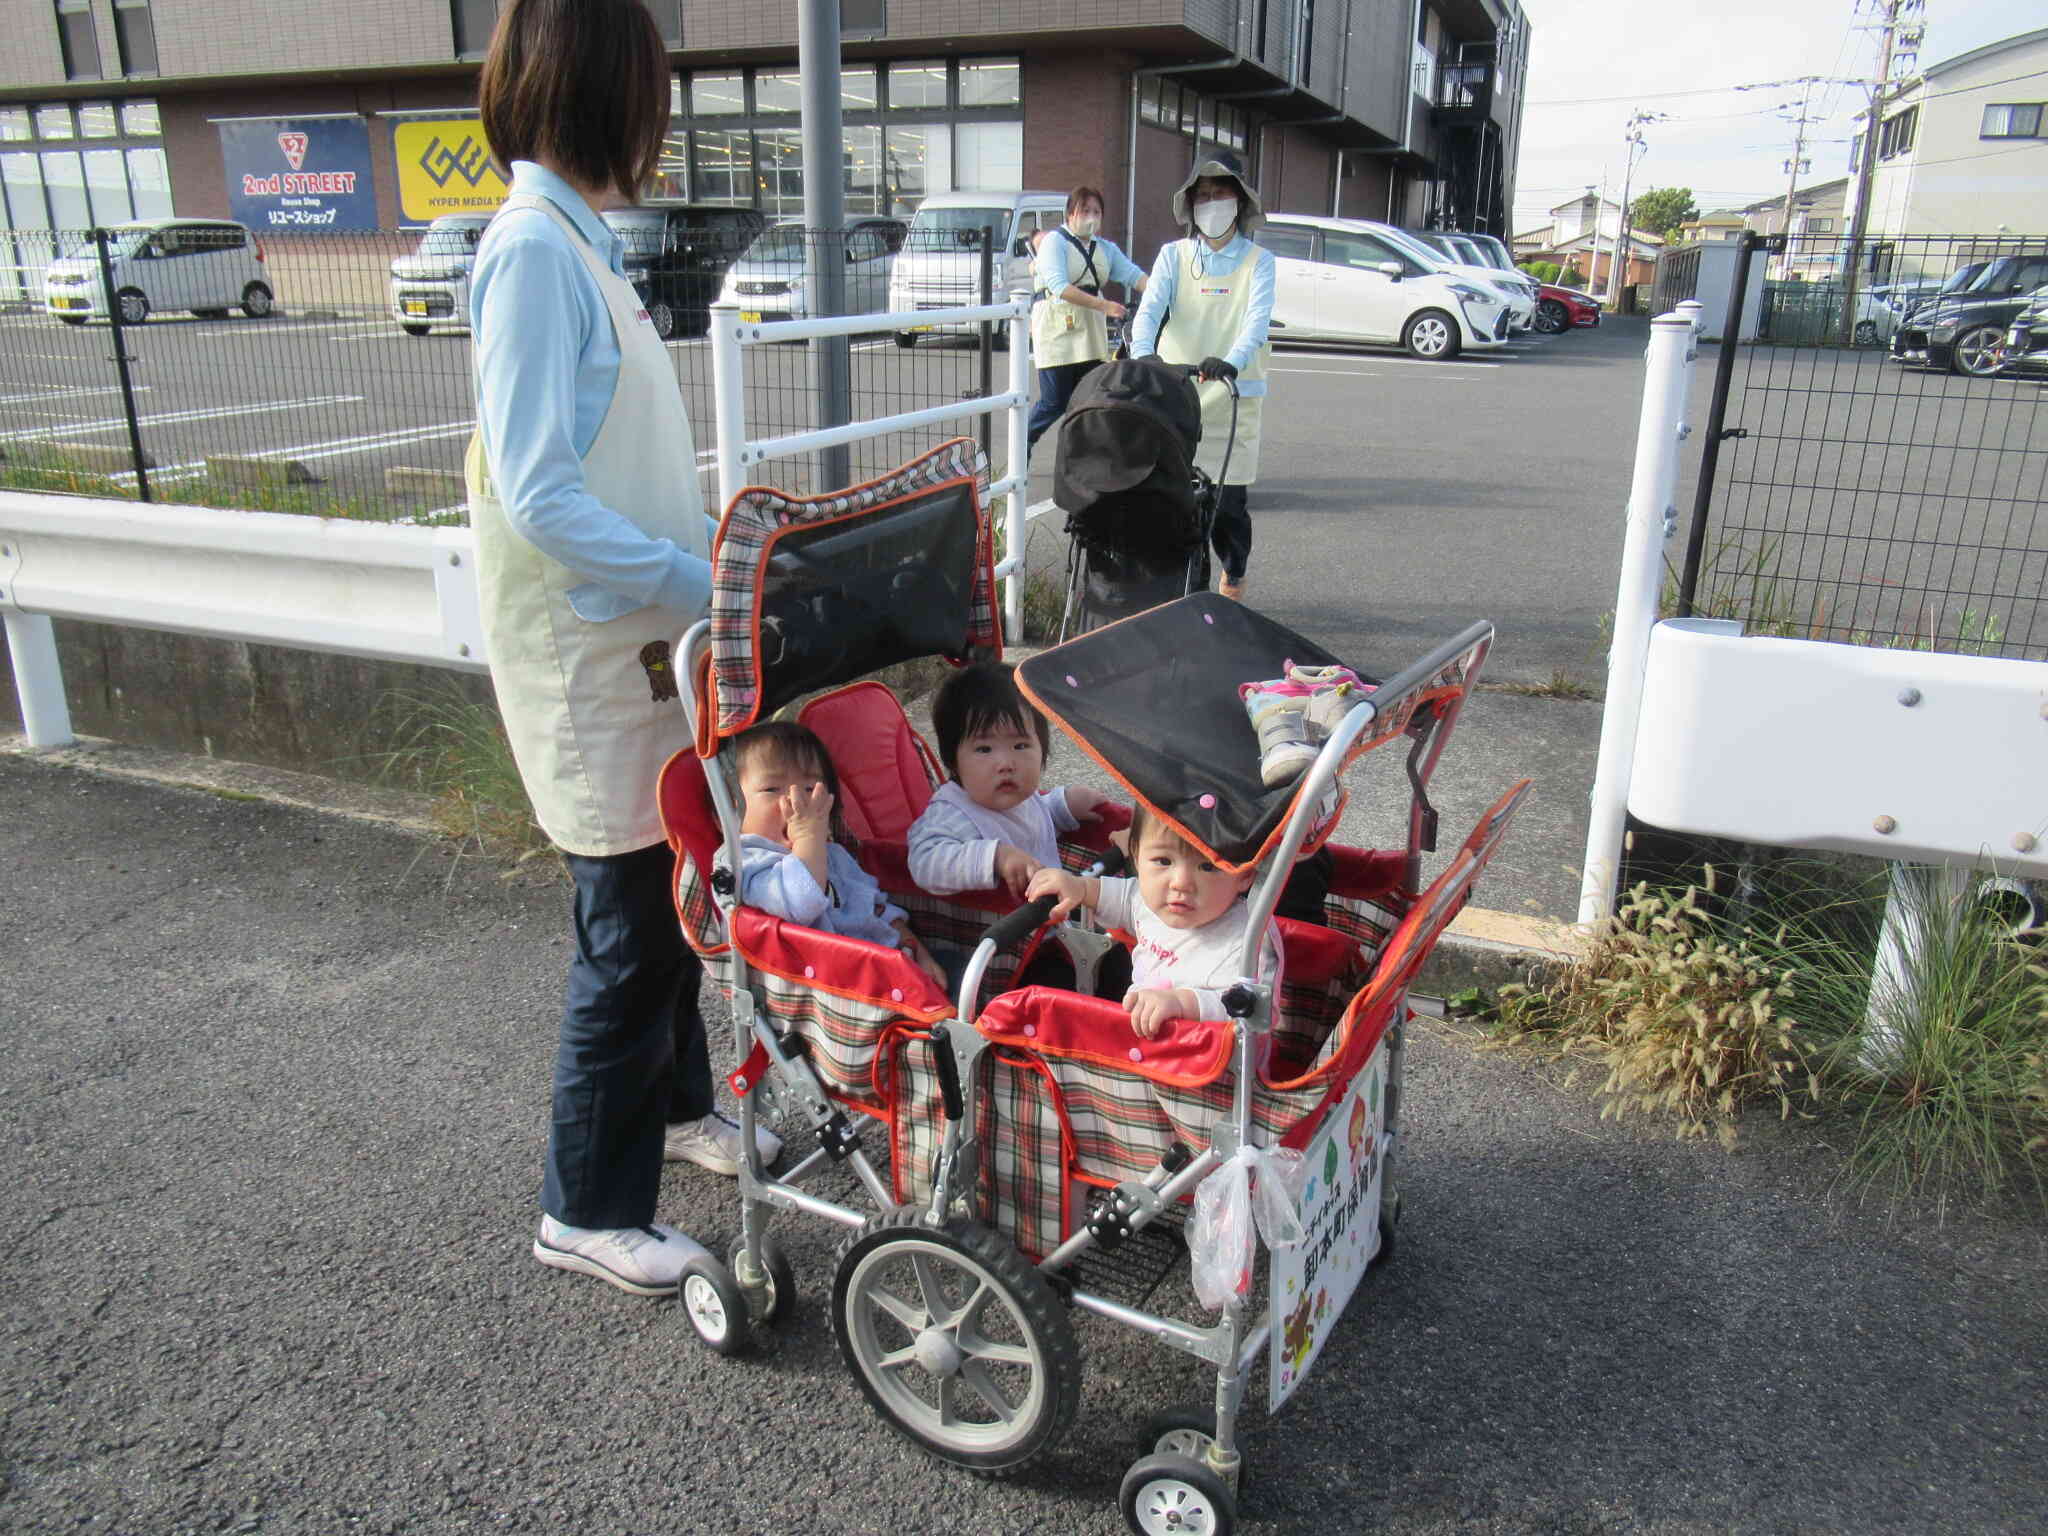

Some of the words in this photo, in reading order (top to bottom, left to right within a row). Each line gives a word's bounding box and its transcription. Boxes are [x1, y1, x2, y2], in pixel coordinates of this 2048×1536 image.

[242, 174, 281, 196] 2nd
[283, 171, 357, 194] STREET
[429, 197, 460, 207] HYPER
[463, 196, 493, 207] MEDIA
[268, 208, 337, 224] リユースショップ
